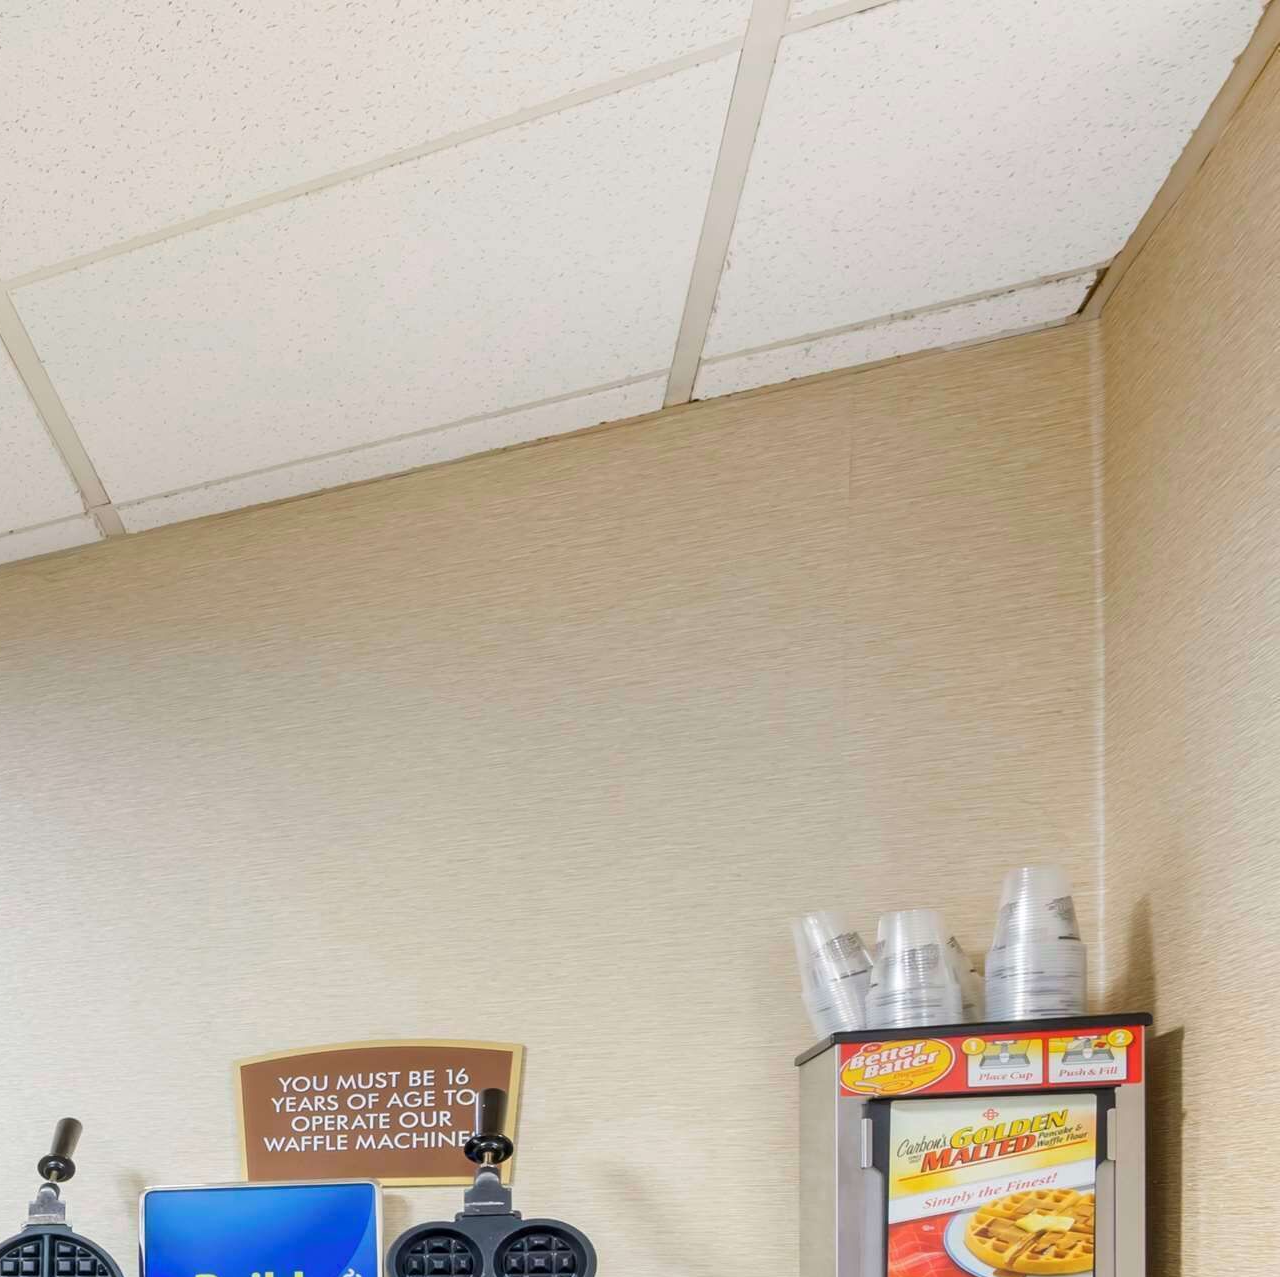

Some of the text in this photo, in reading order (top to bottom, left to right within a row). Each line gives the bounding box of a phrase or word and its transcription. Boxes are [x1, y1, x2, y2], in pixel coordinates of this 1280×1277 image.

[849, 1041, 926, 1070] Better
[863, 1050, 940, 1079] Batter
[279, 1068, 469, 1093] YOU MUST BE 16
[979, 1071, 1033, 1081] Place Cup
[1059, 1066, 1118, 1077] Push & Fill
[272, 1089, 476, 1113] YEARS OF AGE TO
[291, 1111, 452, 1132] OPERATE OUR
[950, 1109, 1069, 1149] GOLDEN
[1039, 1127, 1073, 1139] Pancake
[264, 1130, 475, 1152] WAFFLE MACHINE
[897, 1131, 949, 1158] Carbon's
[1035, 1137, 1064, 1148] Waffle
[921, 1134, 1037, 1173] MALTED
[922, 1171, 1057, 1209] Simply the Finest!
